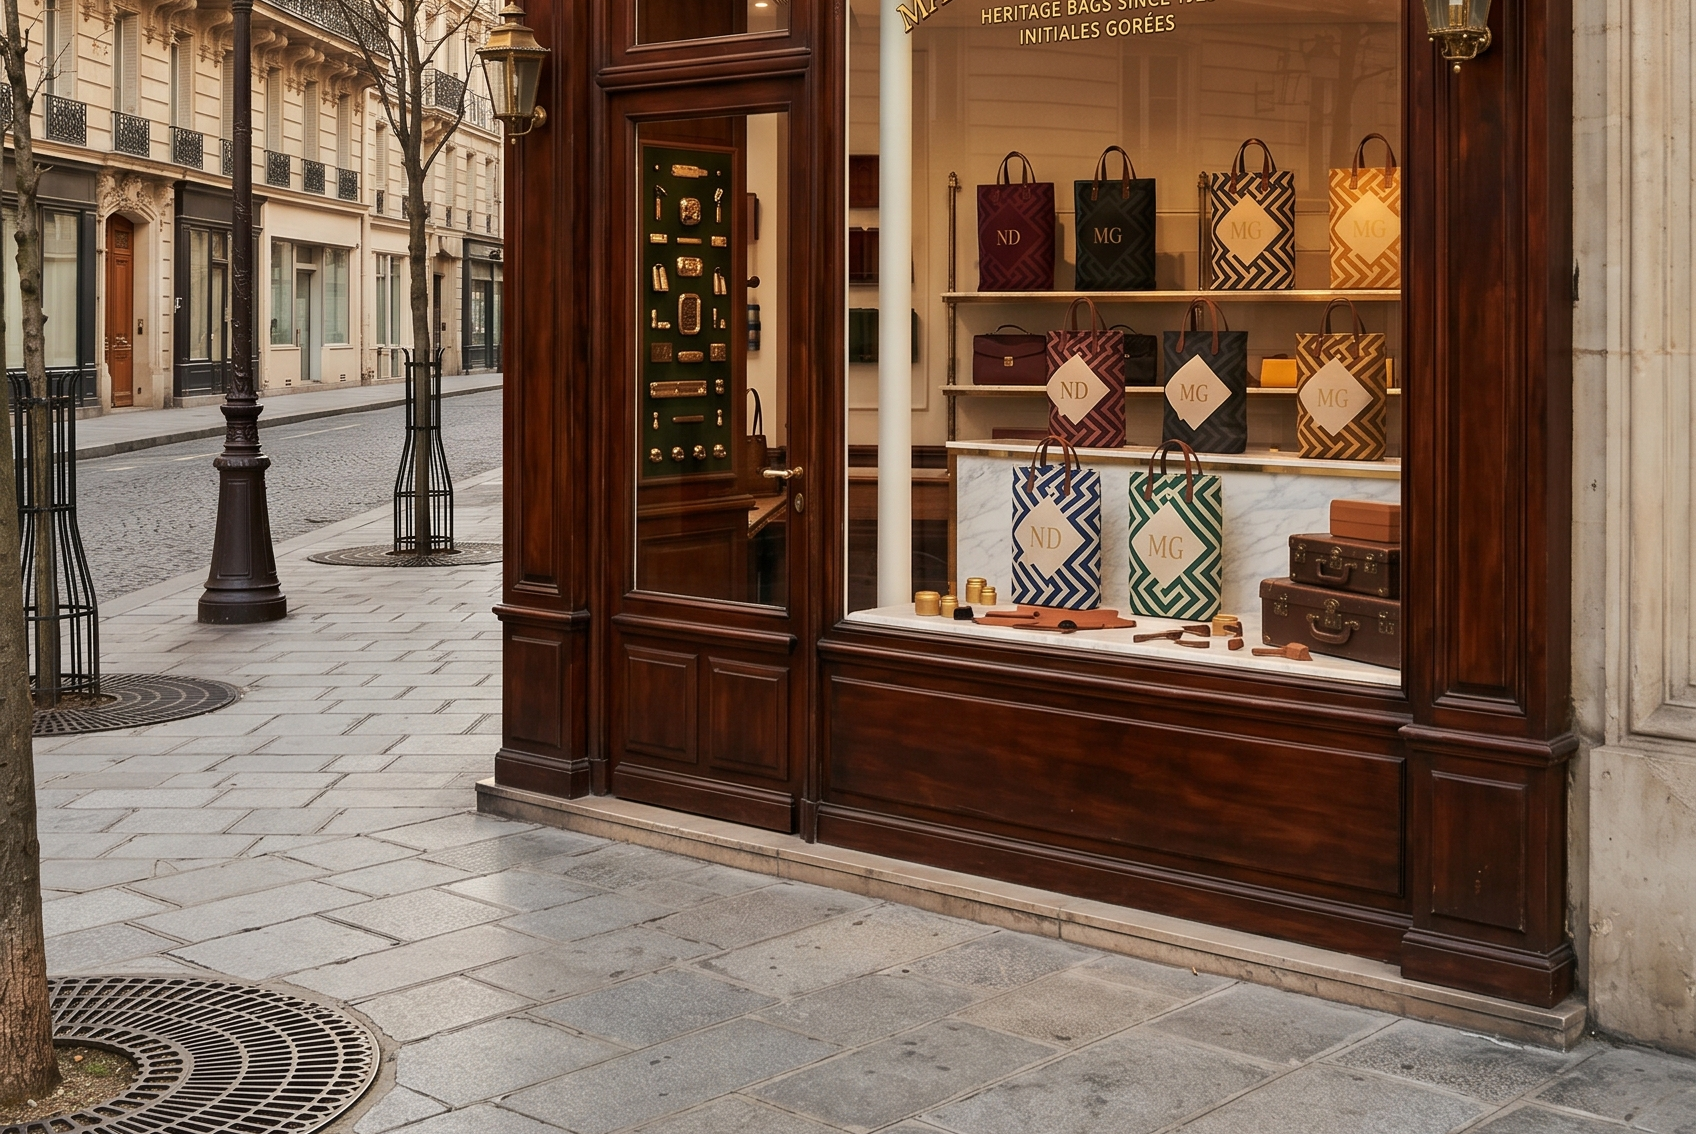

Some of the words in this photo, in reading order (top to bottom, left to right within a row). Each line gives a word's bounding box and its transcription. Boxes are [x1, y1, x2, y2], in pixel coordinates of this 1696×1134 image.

[981, 1, 1062, 24] HERITAGE
[1019, 21, 1100, 45] INITIALES
[1106, 11, 1175, 37] GORÉES
[996, 229, 1021, 246] ND
[1093, 227, 1122, 244] MG
[1230, 220, 1262, 240] MG
[1353, 219, 1386, 238] MG
[1060, 381, 1089, 400] ND
[1180, 383, 1208, 402] MG
[1318, 388, 1349, 408] MG
[1030, 525, 1062, 549] ND
[1148, 534, 1183, 559] MG
